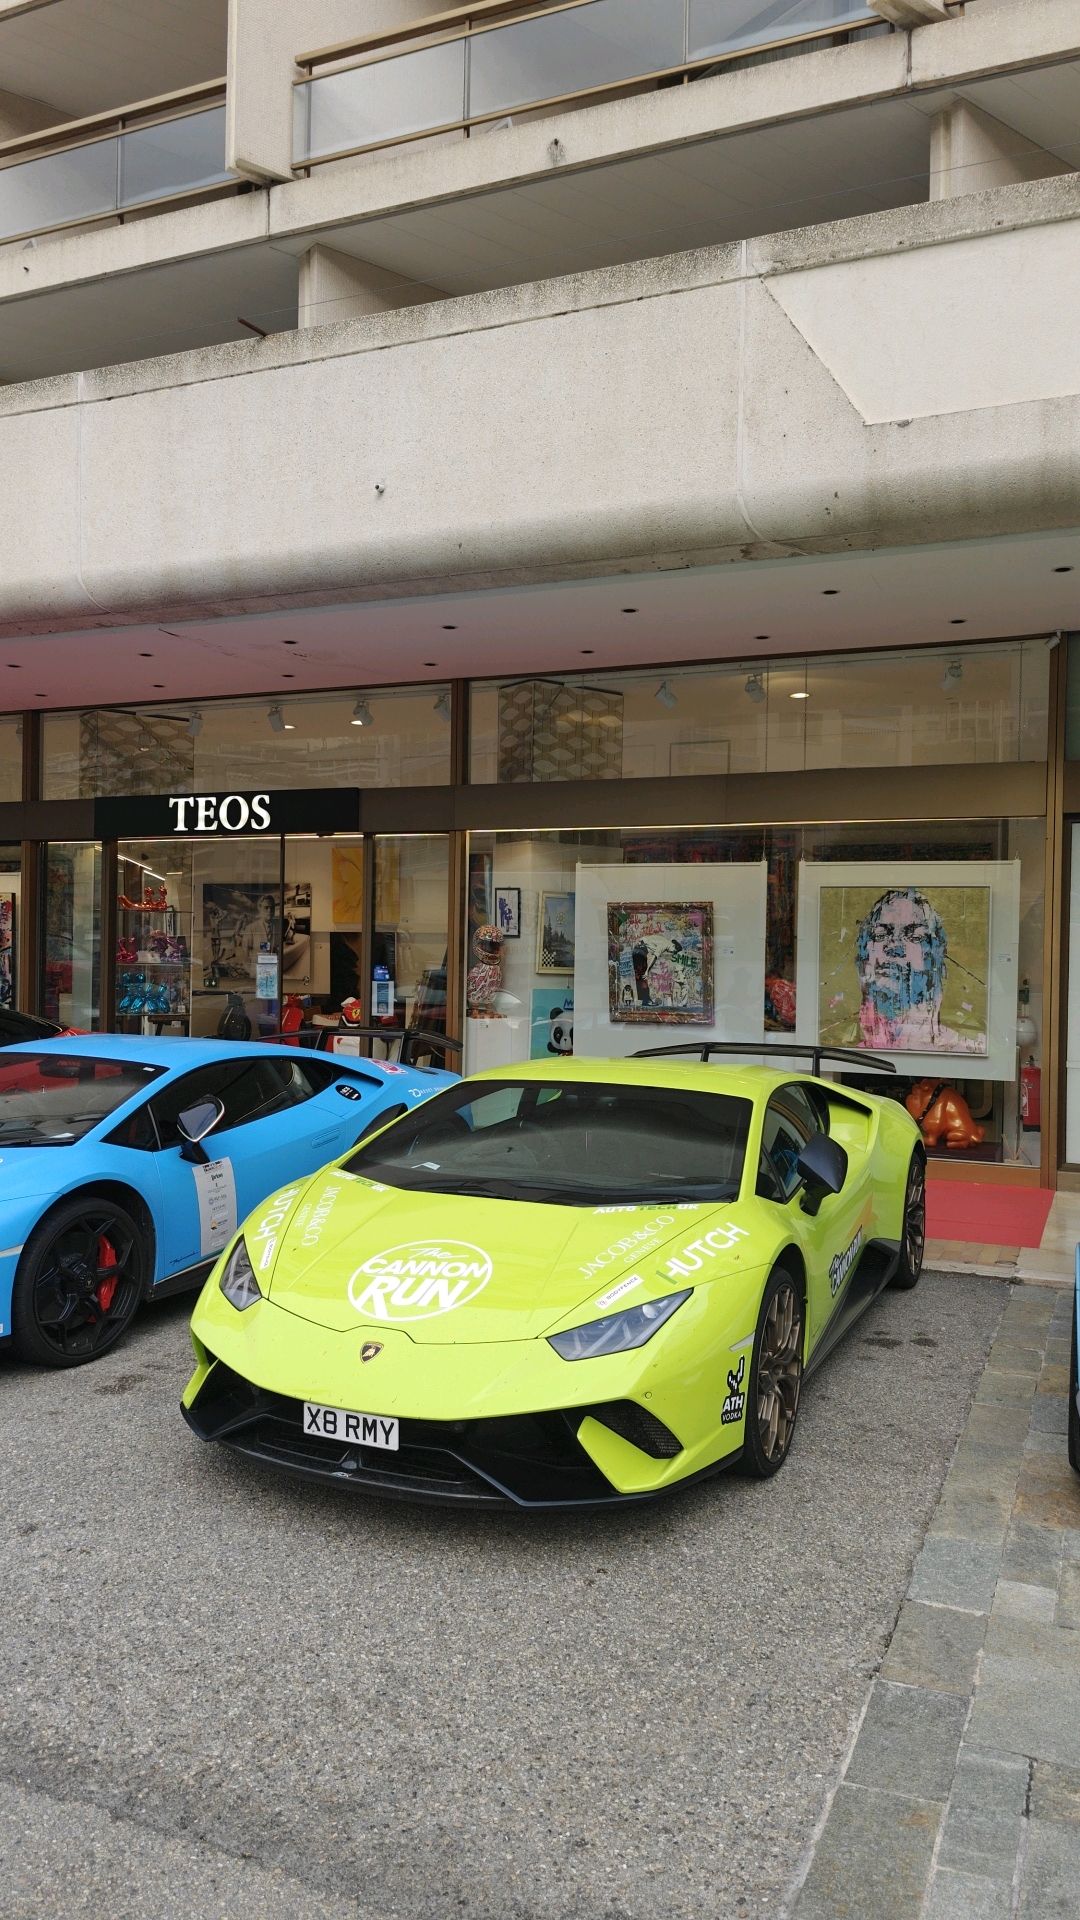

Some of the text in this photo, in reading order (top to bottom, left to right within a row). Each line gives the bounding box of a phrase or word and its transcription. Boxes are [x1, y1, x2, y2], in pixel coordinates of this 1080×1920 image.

[168, 794, 271, 831] TEOS
[671, 953, 698, 969] SMILE
[409, 1247, 470, 1260] The
[578, 1215, 675, 1280] JACOB&CO
[655, 1221, 750, 1285] HUTCH
[362, 1257, 490, 1279] CANNON
[355, 1274, 471, 1319] RUN
[605, 1276, 639, 1300] BODYFENCE
[723, 1394, 744, 1412] ATH
[306, 1405, 395, 1446] X8 RMY
[722, 1410, 742, 1421] VODKA
